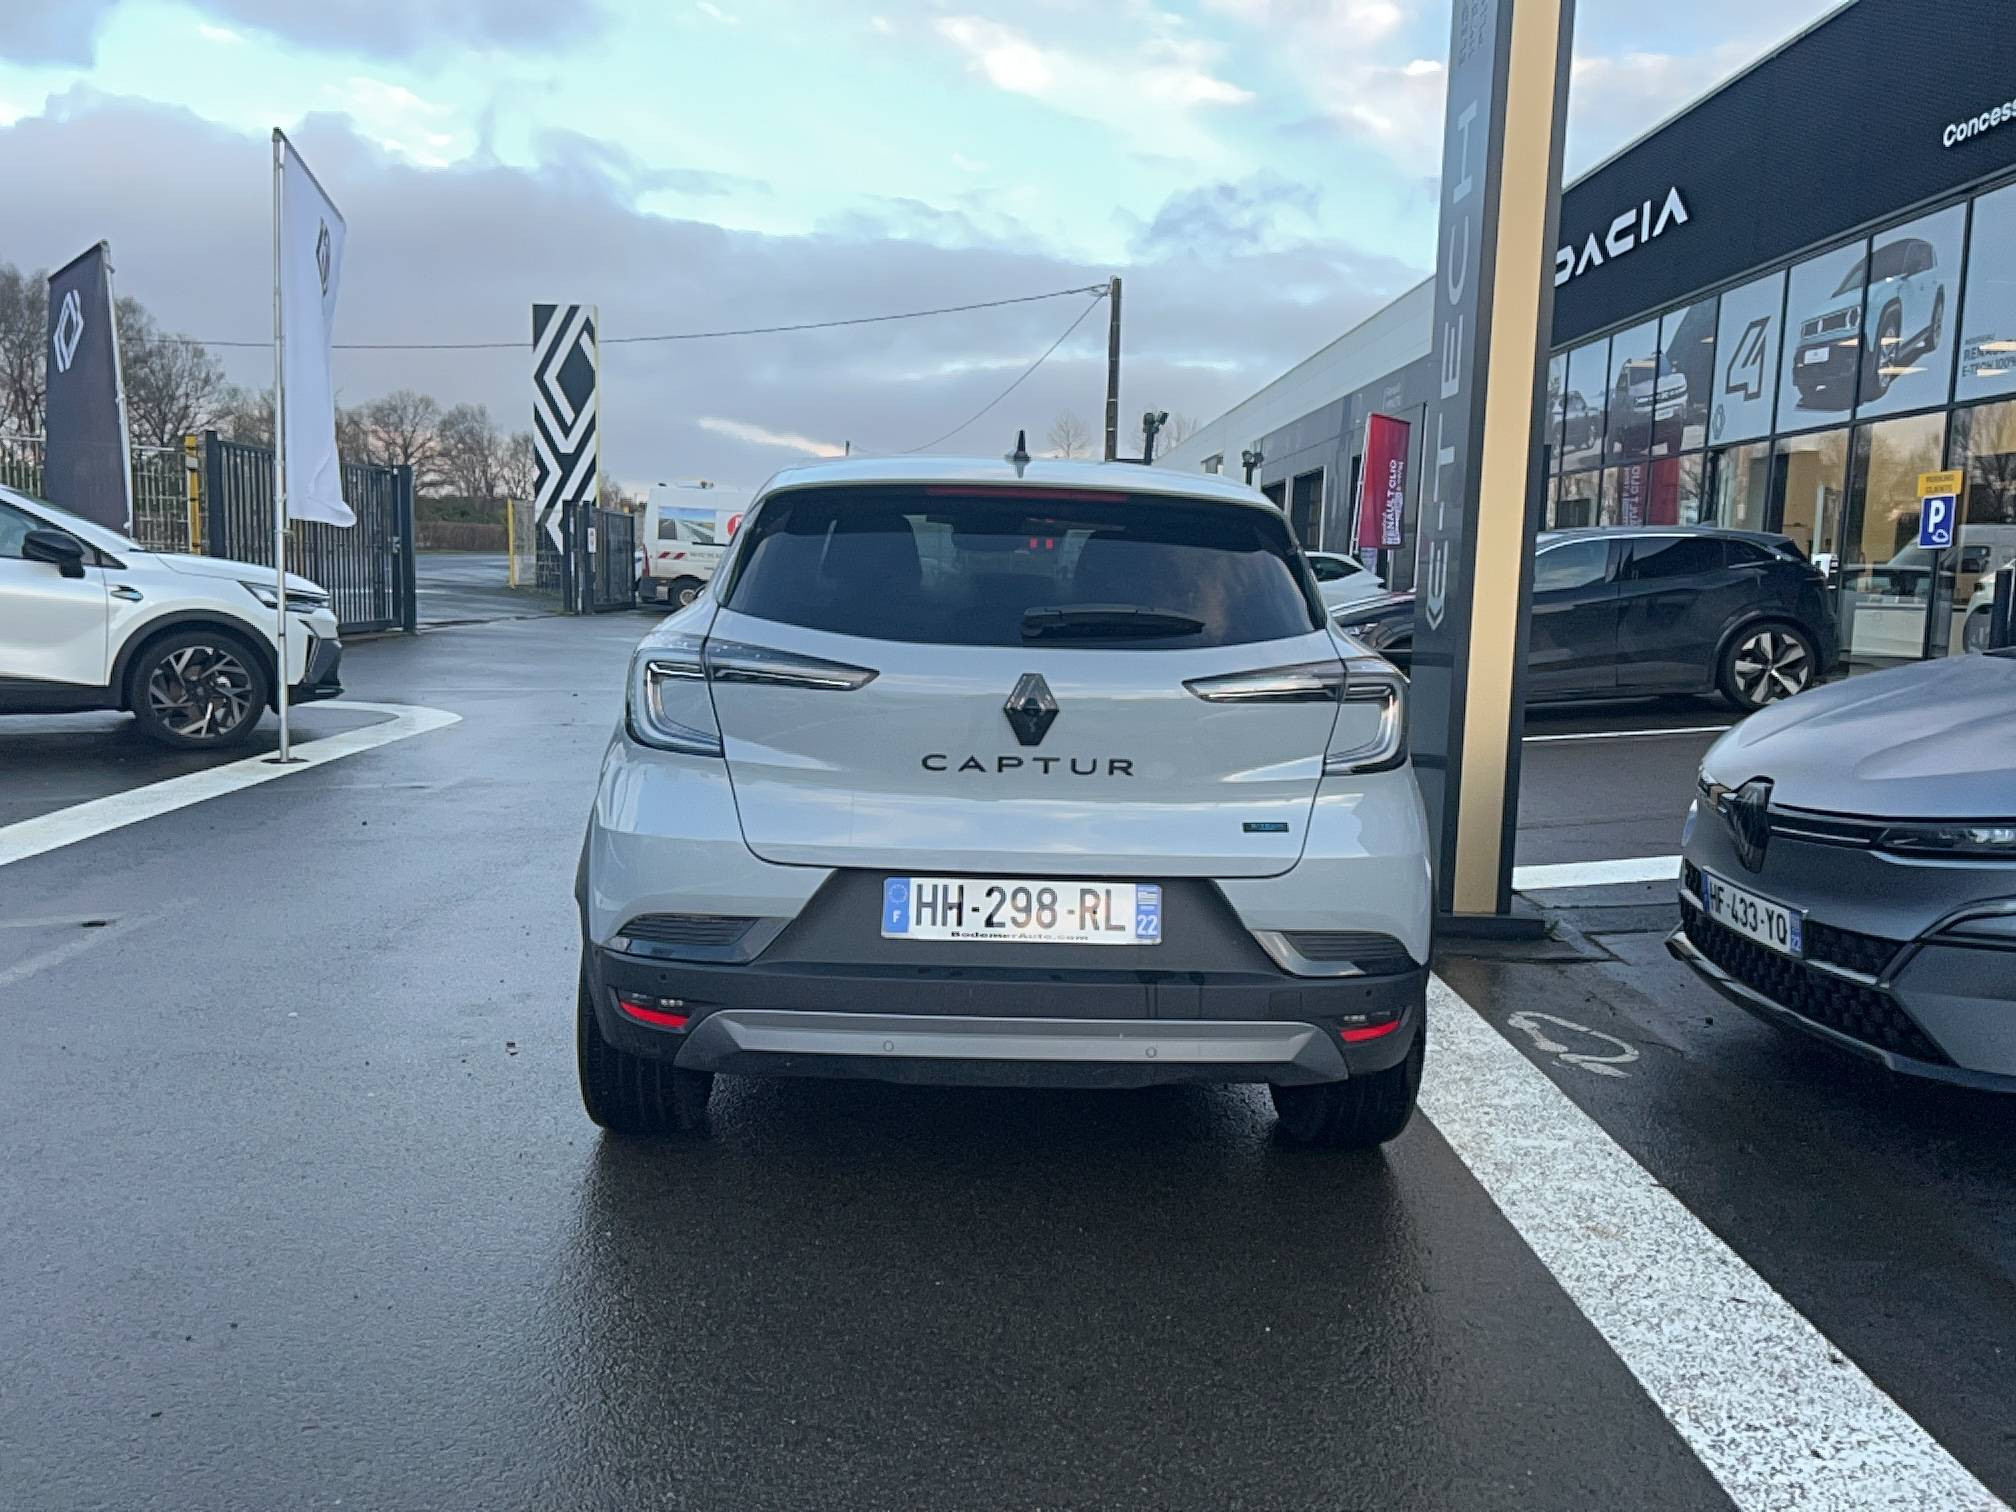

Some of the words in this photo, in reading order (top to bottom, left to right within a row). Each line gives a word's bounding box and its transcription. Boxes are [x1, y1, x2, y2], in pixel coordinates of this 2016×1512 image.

[1554, 186, 1688, 288] DACIA
[1928, 500, 1946, 533] P
[921, 754, 1134, 776] CAPTUR
[892, 910, 902, 924] F
[915, 883, 1126, 932] HH-298-RL
[1137, 914, 1158, 936] 22
